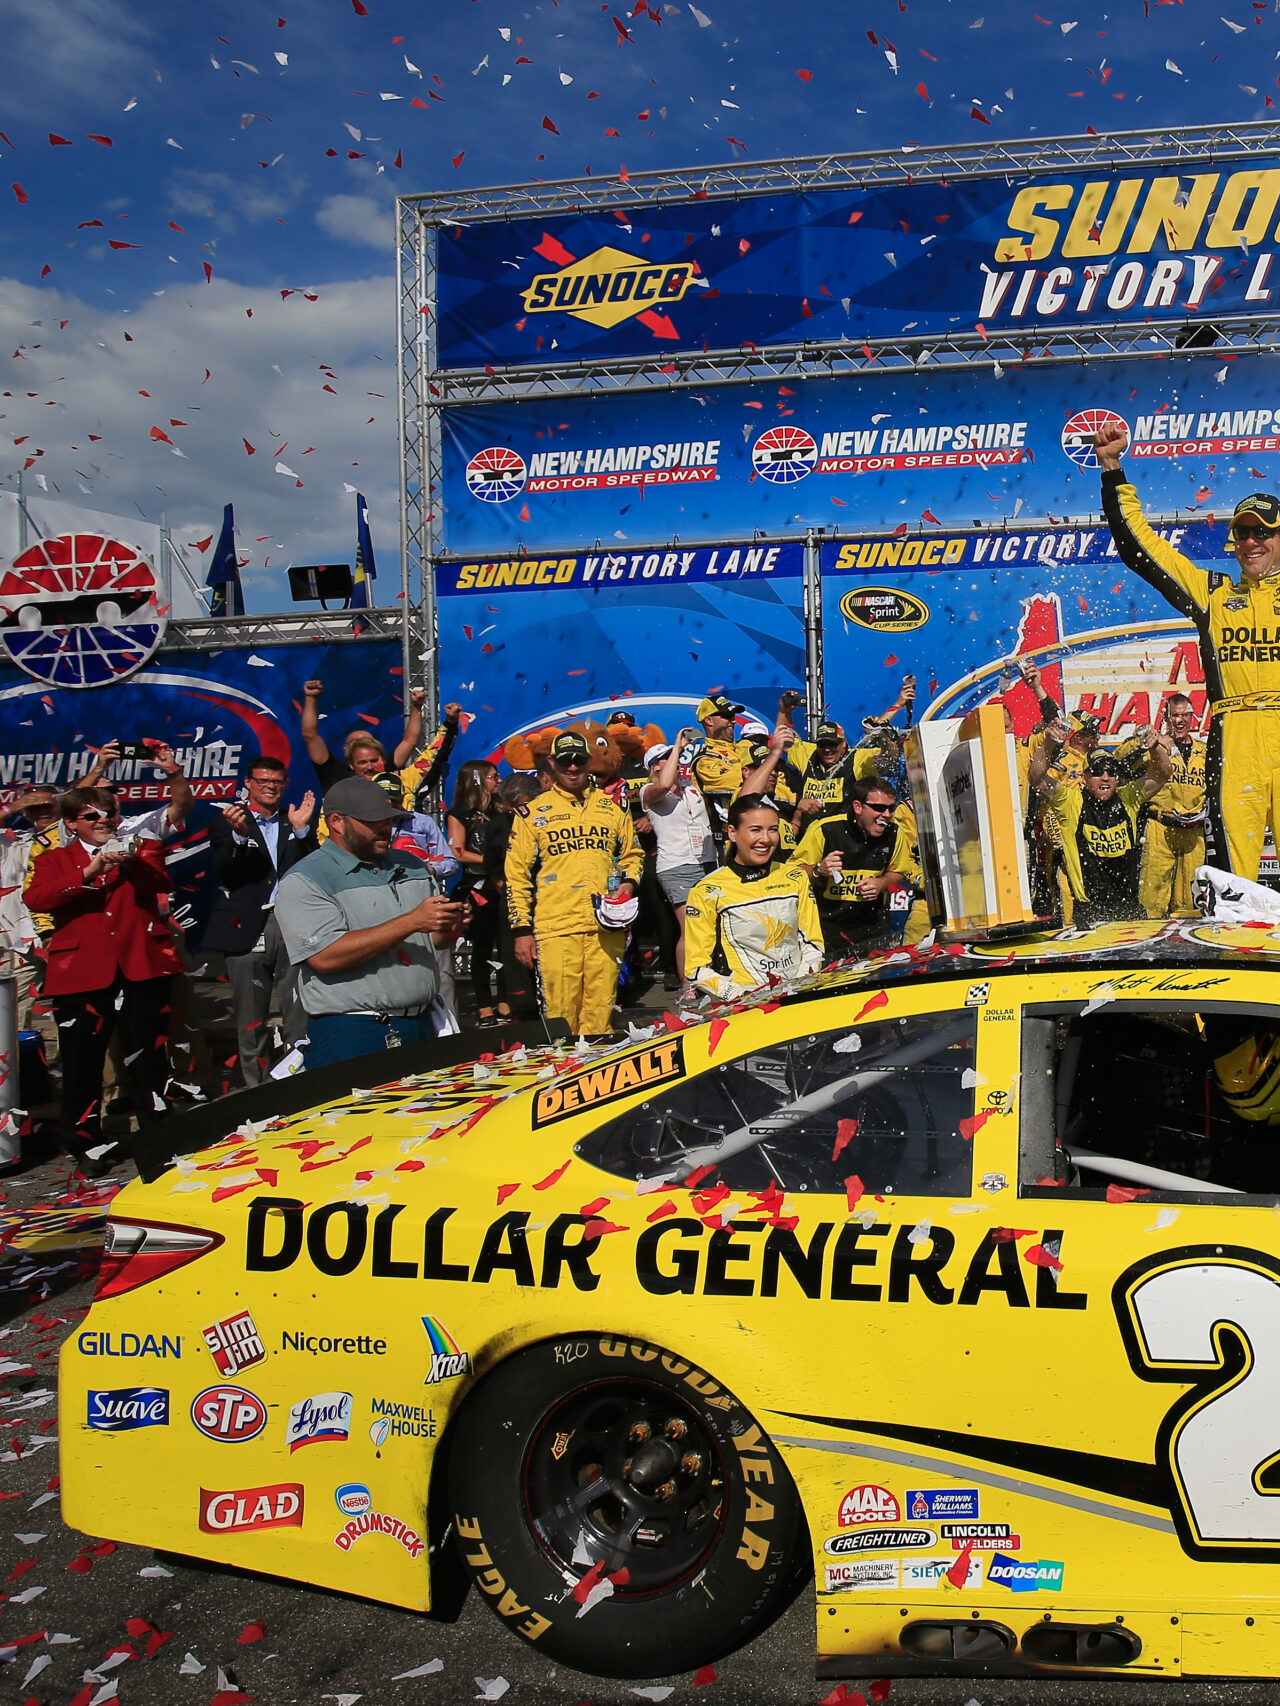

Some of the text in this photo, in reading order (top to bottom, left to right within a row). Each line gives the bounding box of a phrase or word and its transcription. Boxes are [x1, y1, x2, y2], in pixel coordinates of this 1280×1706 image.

[529, 267, 684, 312] SUNOCO
[978, 255, 1222, 320] VICTORY
[1134, 414, 1195, 441] NEW
[820, 421, 1028, 457] NEW HAMPSHIRE
[1134, 441, 1213, 456] MOTOR
[529, 440, 721, 478] NEW HAMPSHIRE
[820, 450, 1019, 472] MOTOR SPEEDWAY
[529, 468, 714, 491] MOTOR SPEEDWAY
[835, 528, 1185, 570] SUNOCO VICTORY LE
[456, 547, 781, 589] SUNOCO VICTORY LANE
[864, 595, 895, 607] NASCAR
[870, 606, 899, 619] Sprint
[0, 752, 64, 786] NEW
[117, 782, 234, 800] PEEDWAY
[546, 826, 610, 843] DOLLAR
[1091, 829, 1126, 842] DOLLAR
[547, 838, 610, 857] GENERAL
[1089, 840, 1126, 853] GENERA
[759, 954, 794, 973] Sprint
[983, 1180, 1003, 1190] 25
[247, 1197, 1089, 1311] DOLLAR GENERAL
[78, 1332, 181, 1359] GILDAN
[203, 1314, 258, 1355] slim
[424, 1352, 470, 1384] XTRA
[90, 1392, 166, 1421] Suave
[200, 1392, 259, 1434] STP
[292, 1395, 349, 1435] Lysol
[371, 1398, 437, 1422] MAXWELL
[391, 1419, 437, 1438] HOUSE
[204, 1489, 300, 1529] GLAD
[841, 1486, 898, 1513] MAC
[934, 1494, 972, 1503] SHERWIN
[841, 1511, 898, 1524] TOOLS
[335, 1513, 425, 1559] DRUMSTICK
[835, 1532, 927, 1551] FREIGHTLINER
[944, 1525, 1007, 1538] LINCOLN
[958, 1538, 1014, 1549] WELDERS
[455, 1513, 554, 1641] EAGLE
[829, 1566, 851, 1581] MC
[852, 1563, 894, 1572] MACHINERY
[911, 1566, 973, 1579] SIEMS
[988, 1566, 1062, 1581] DOOSAN
